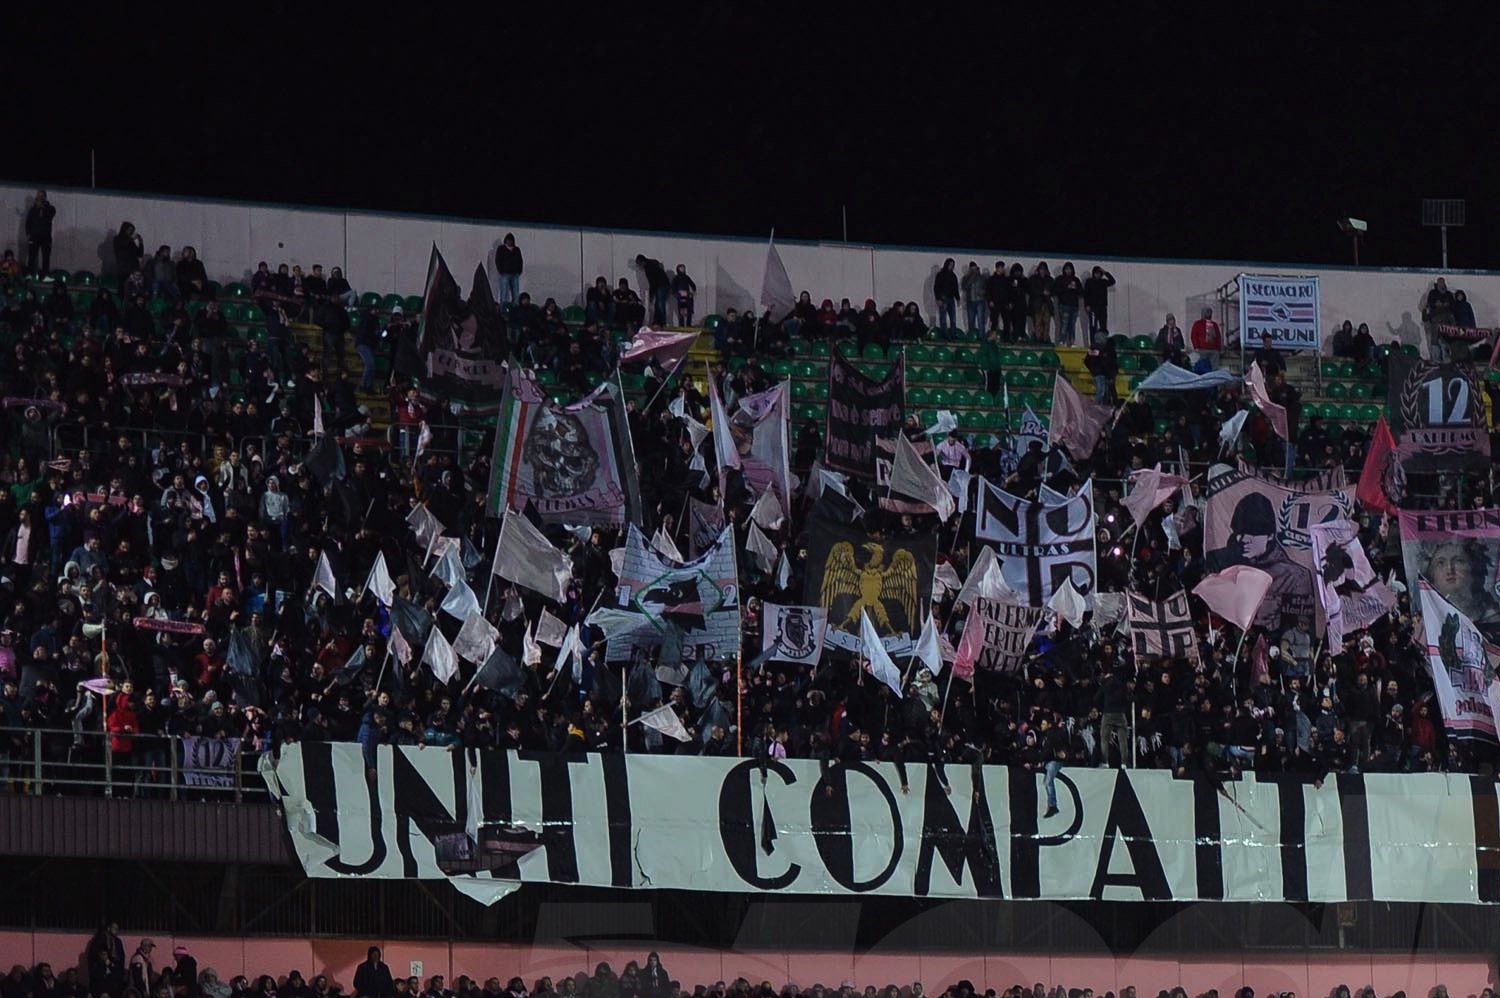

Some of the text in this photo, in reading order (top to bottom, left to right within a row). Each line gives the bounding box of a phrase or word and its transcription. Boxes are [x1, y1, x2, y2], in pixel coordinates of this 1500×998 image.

[1247, 327, 1315, 342] BARUNI
[1421, 376, 1472, 425] 12
[999, 542, 1071, 556] ULTRAS
[301, 742, 632, 888] UNITI
[718, 758, 1375, 902] COMPATTI
